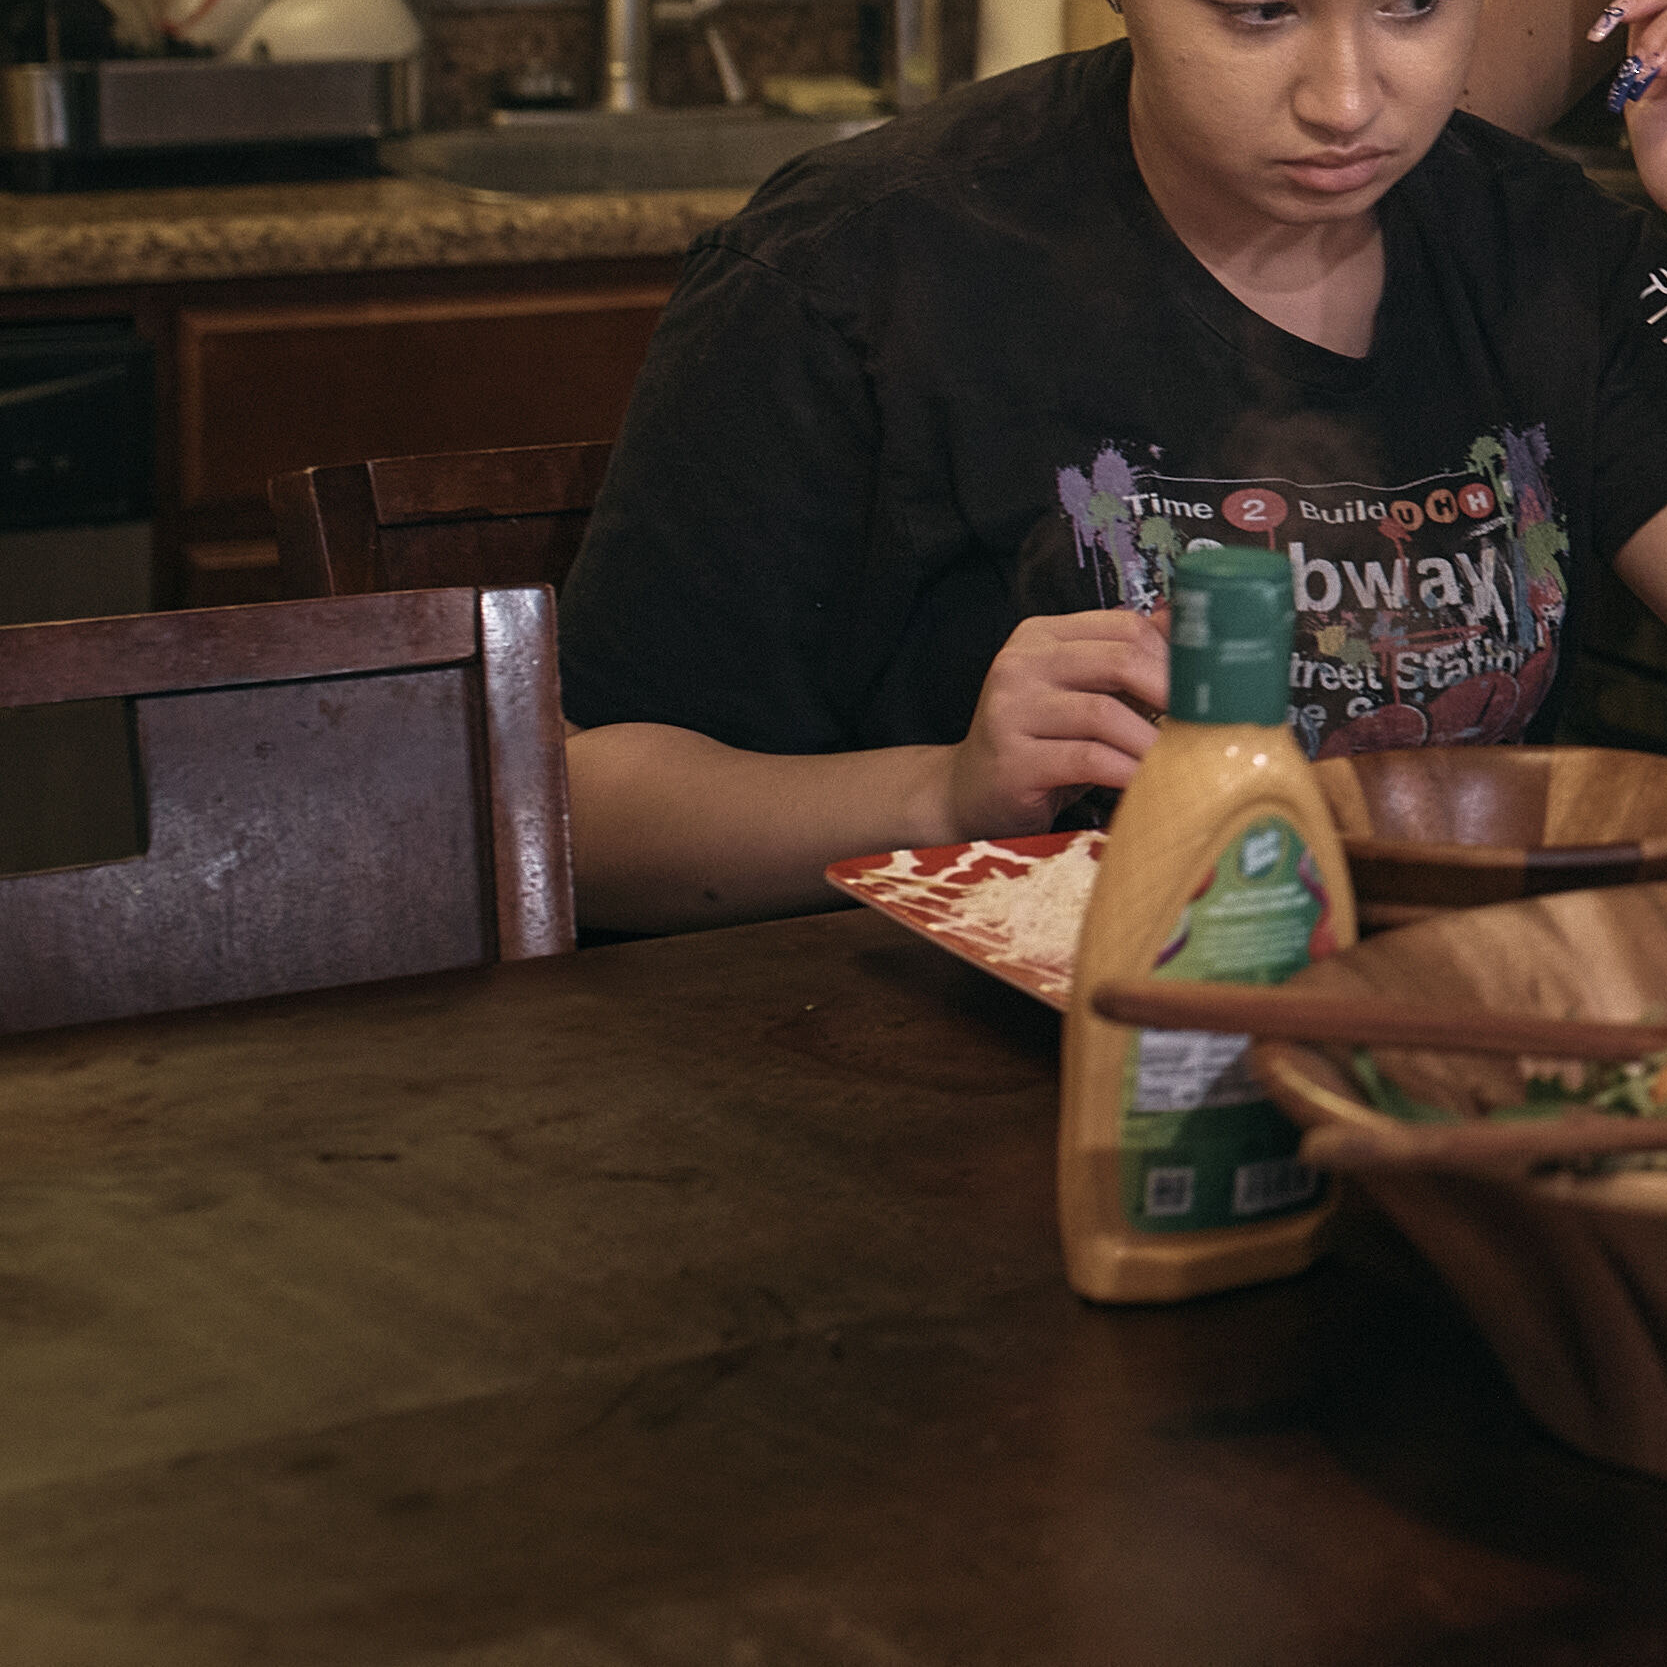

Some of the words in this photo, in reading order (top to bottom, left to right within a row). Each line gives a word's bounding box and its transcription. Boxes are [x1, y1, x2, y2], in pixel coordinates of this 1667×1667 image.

[1122, 492, 1214, 521] Time
[1299, 498, 1387, 525] Build
[1289, 647, 1383, 691] treet
